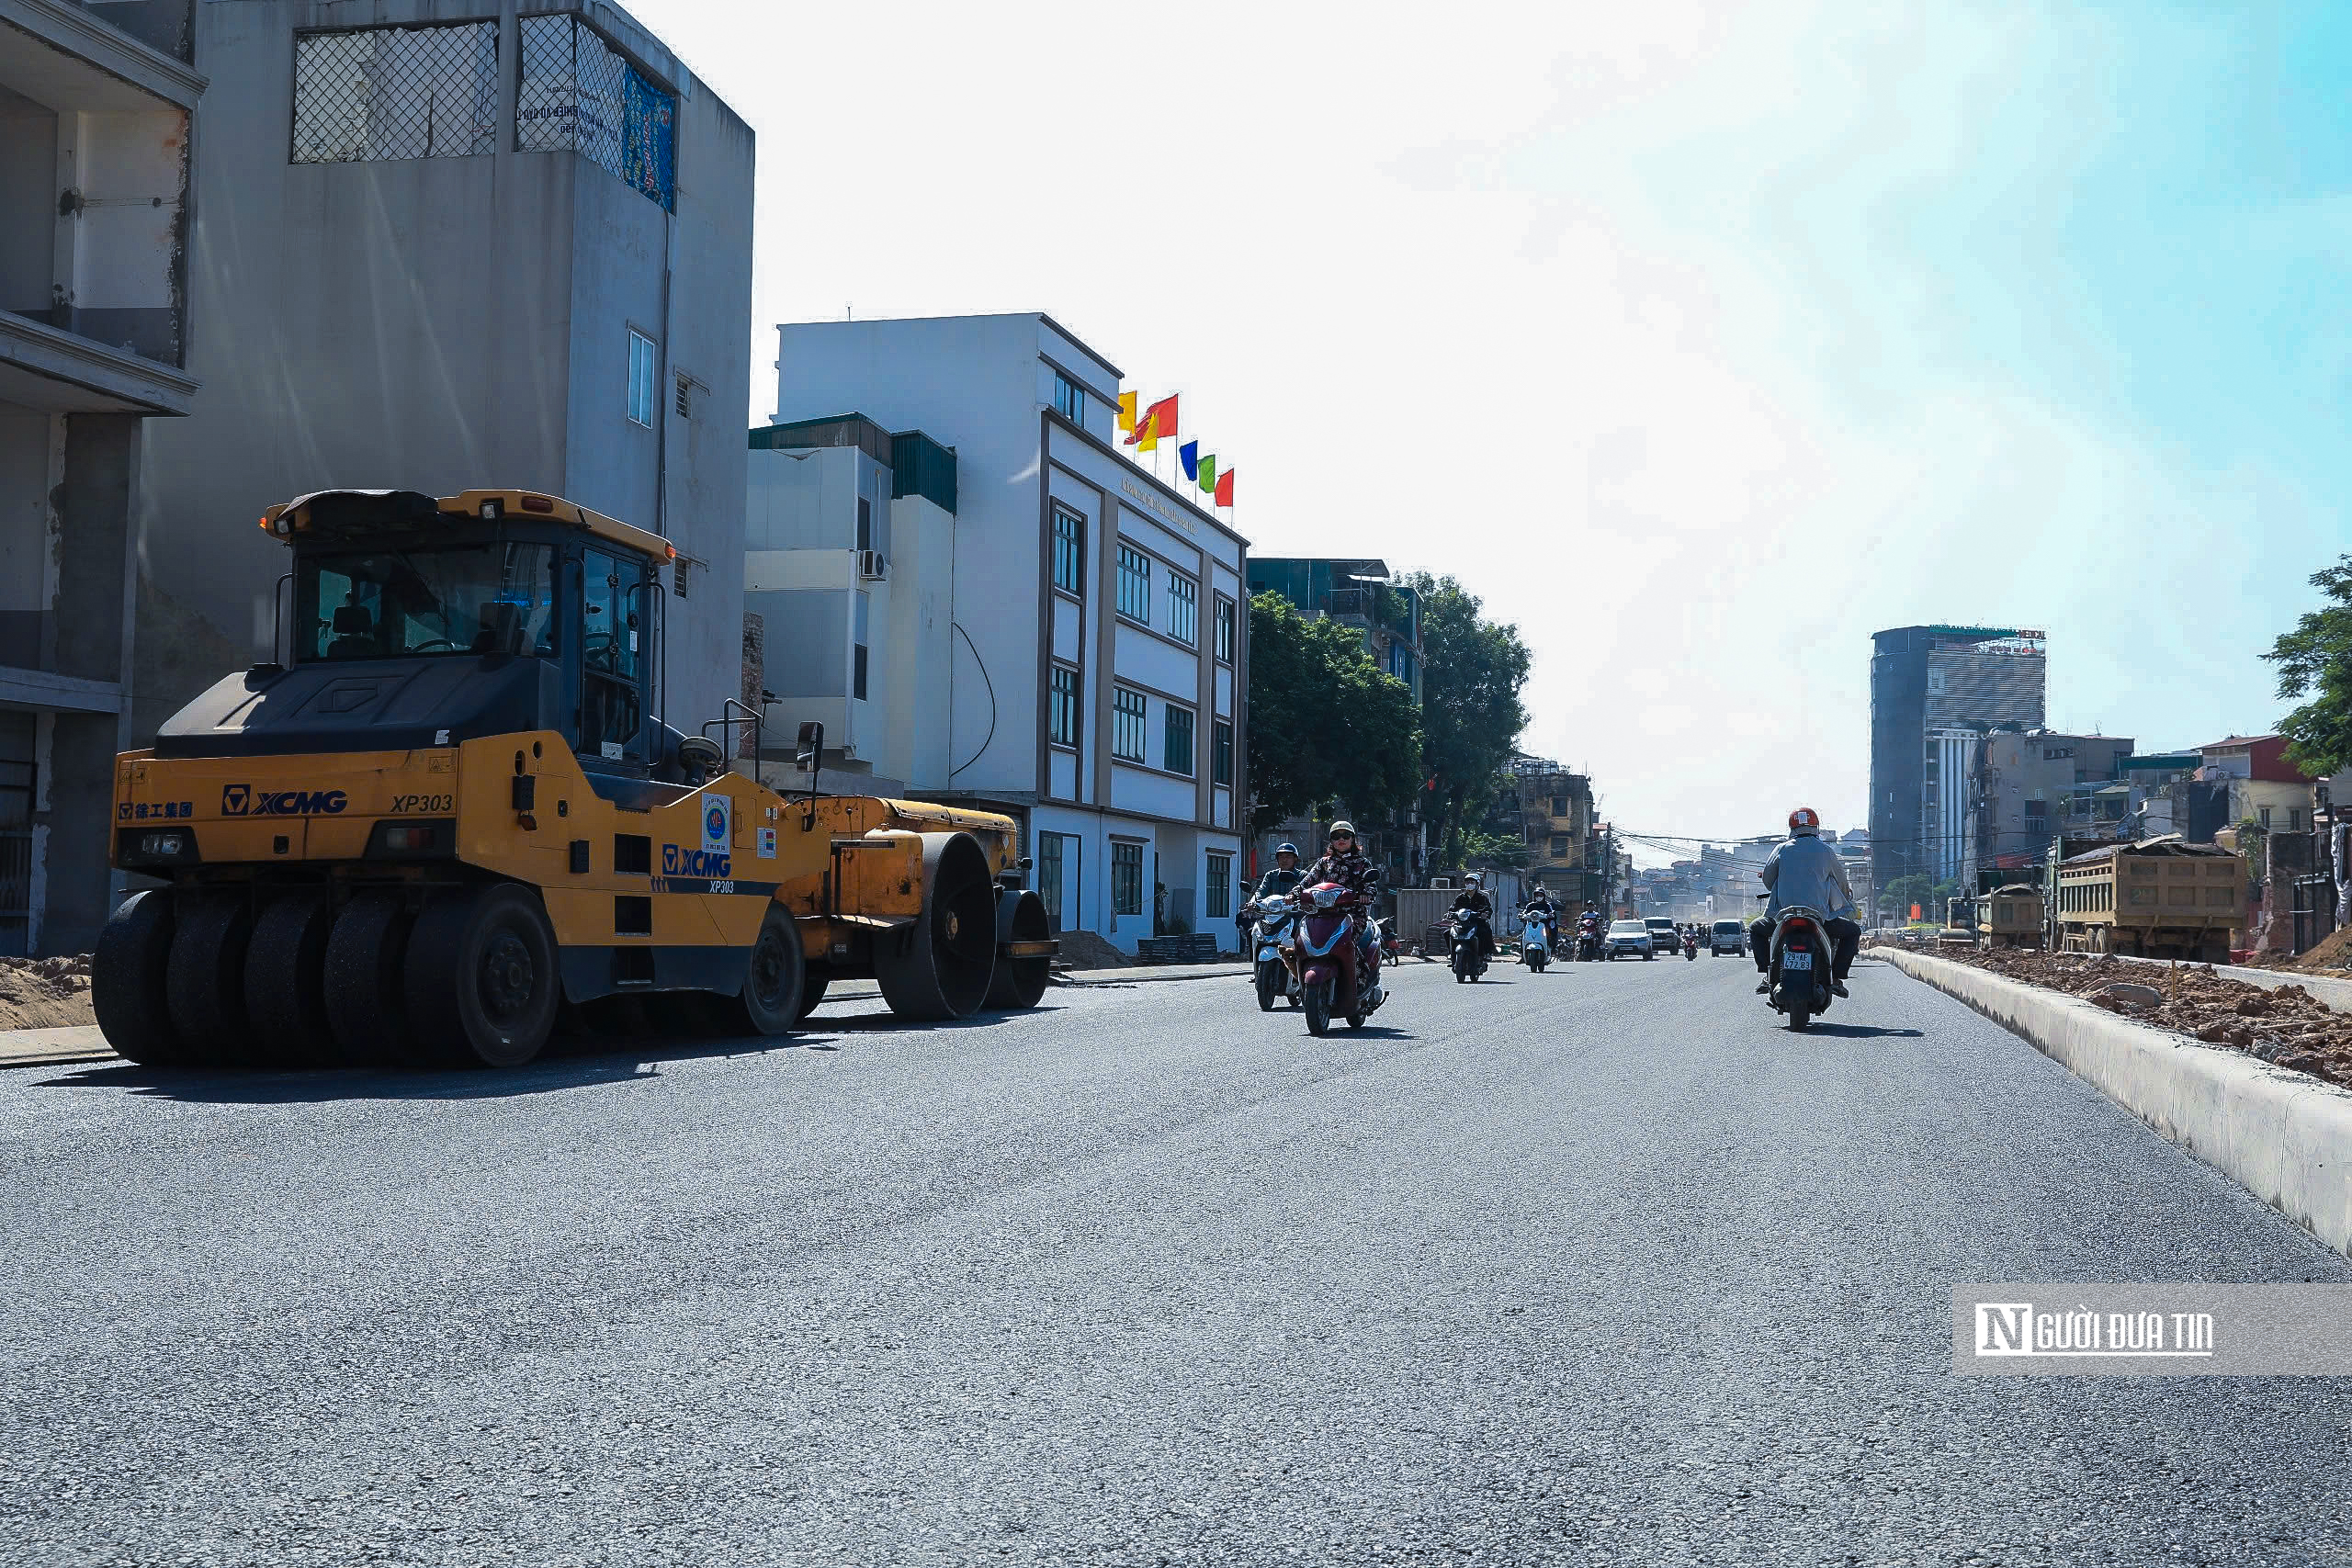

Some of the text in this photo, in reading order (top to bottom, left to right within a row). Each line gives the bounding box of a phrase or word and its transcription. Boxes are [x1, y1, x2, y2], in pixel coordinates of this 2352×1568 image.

[135, 801, 193, 819] 徐工集团
[250, 790, 348, 817] XCMG
[390, 795, 453, 814] XP303
[679, 848, 731, 878] XCMG
[709, 880, 734, 894] XP303
